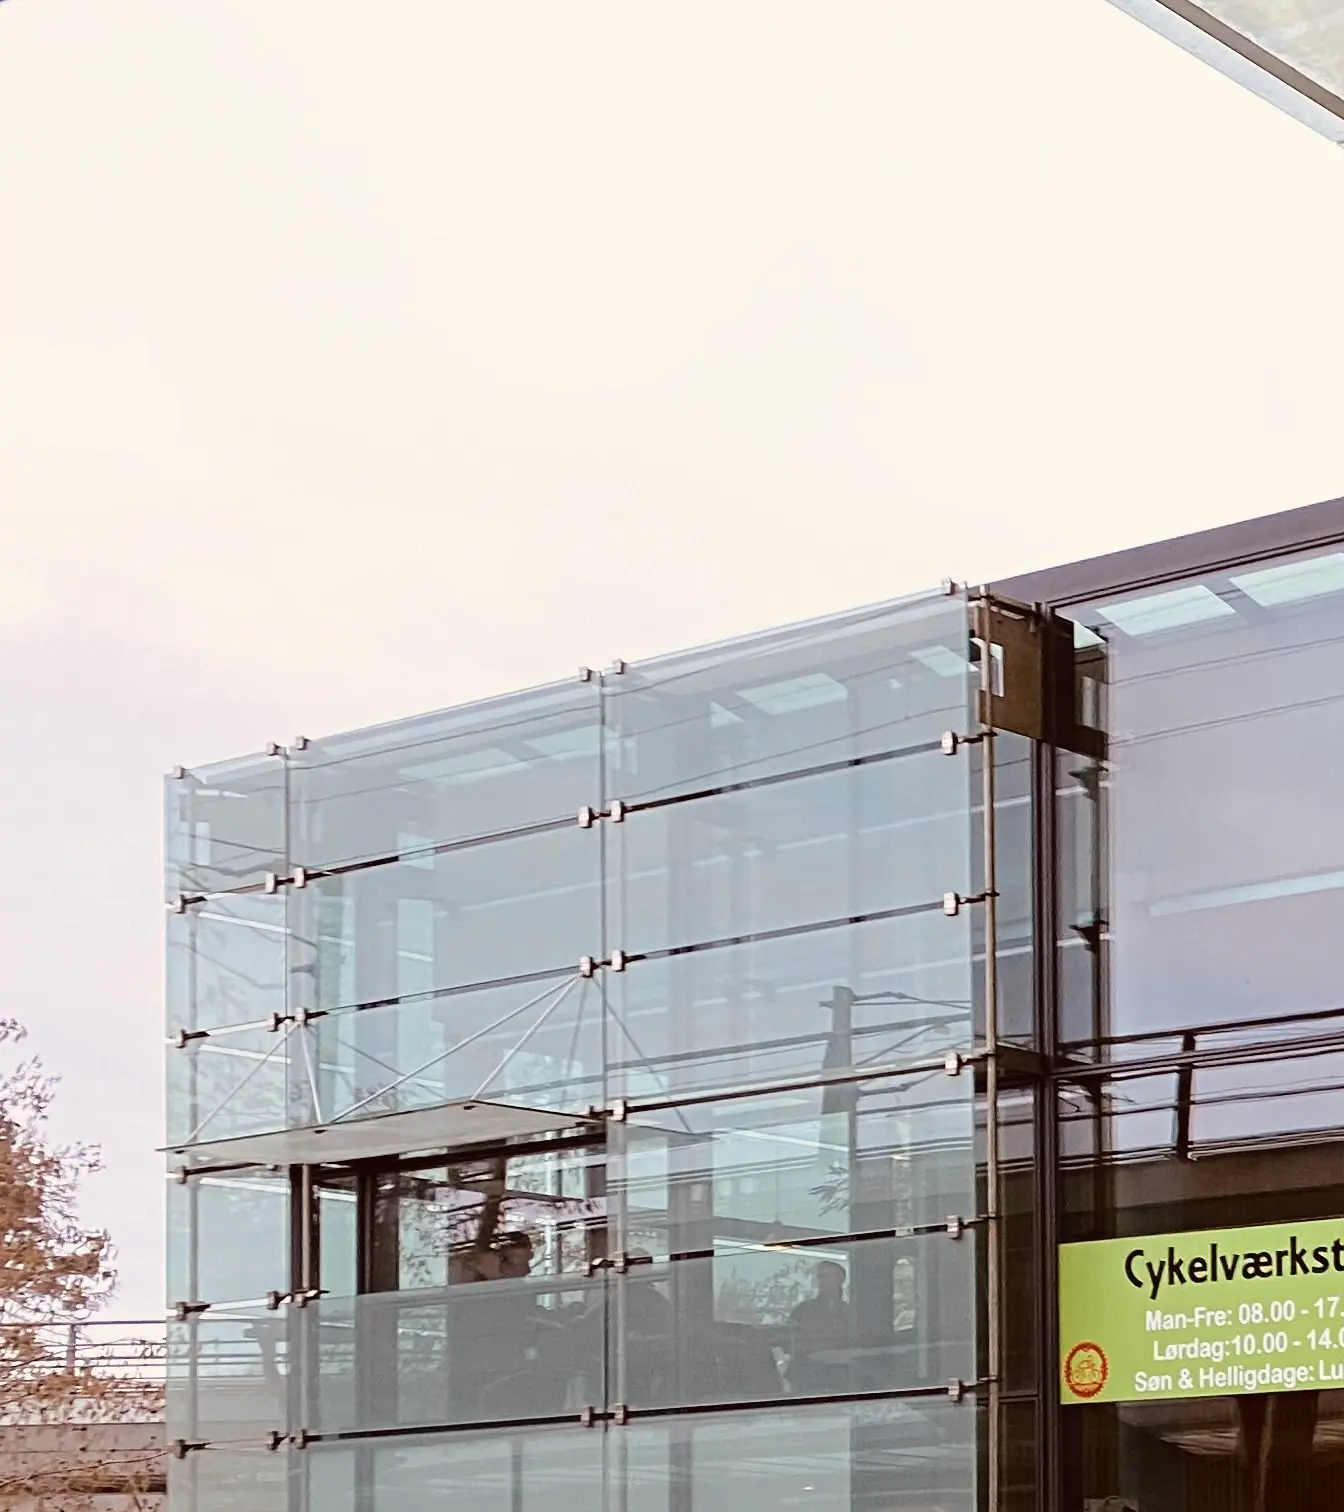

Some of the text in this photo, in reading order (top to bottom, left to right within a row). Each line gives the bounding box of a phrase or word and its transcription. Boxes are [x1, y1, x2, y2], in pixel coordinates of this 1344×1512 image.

[1145, 1306, 1232, 1332] Man-Fre:
[1239, 1300, 1295, 1325] 08.00
[1135, 1370, 1171, 1393] Søn
[1179, 1367, 1194, 1389] &
[1199, 1359, 1314, 1391] Helligdage:
